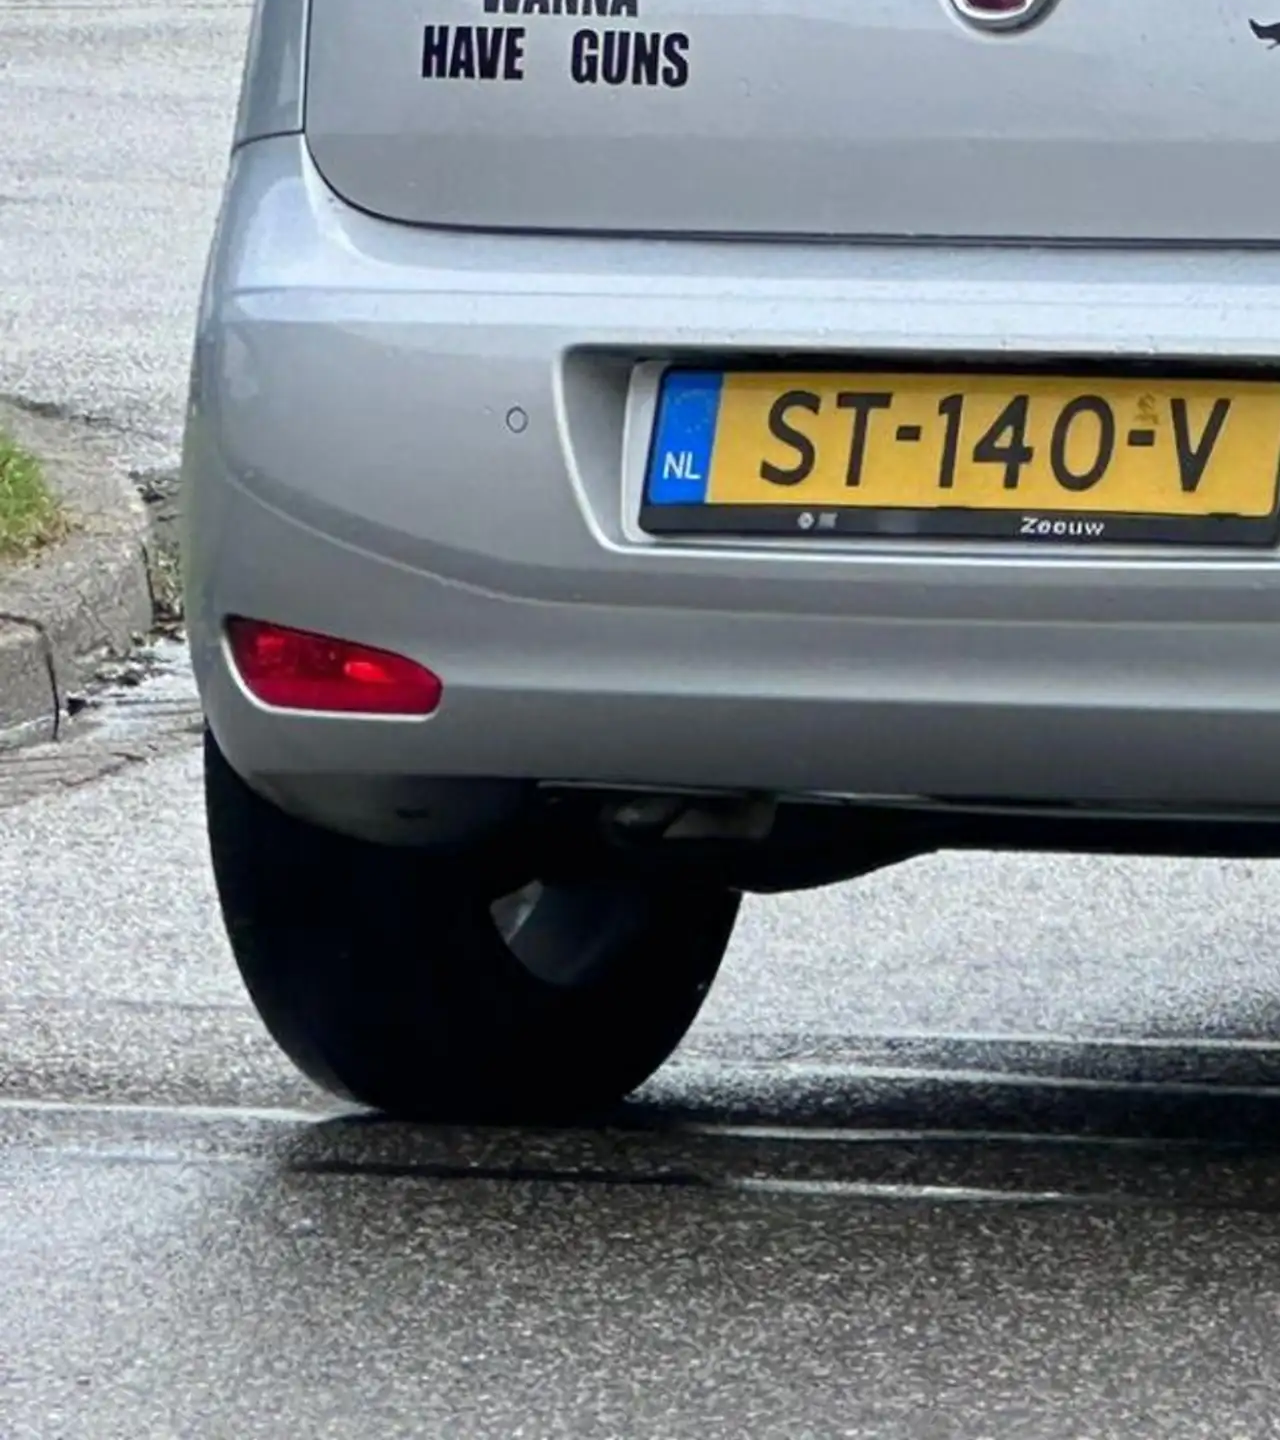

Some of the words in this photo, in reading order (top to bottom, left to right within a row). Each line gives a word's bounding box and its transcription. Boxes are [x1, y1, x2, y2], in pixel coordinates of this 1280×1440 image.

[421, 25, 526, 80] HAVE
[571, 29, 689, 88] GUNS
[663, 451, 700, 480] NL
[760, 390, 1231, 492] ST-140-V
